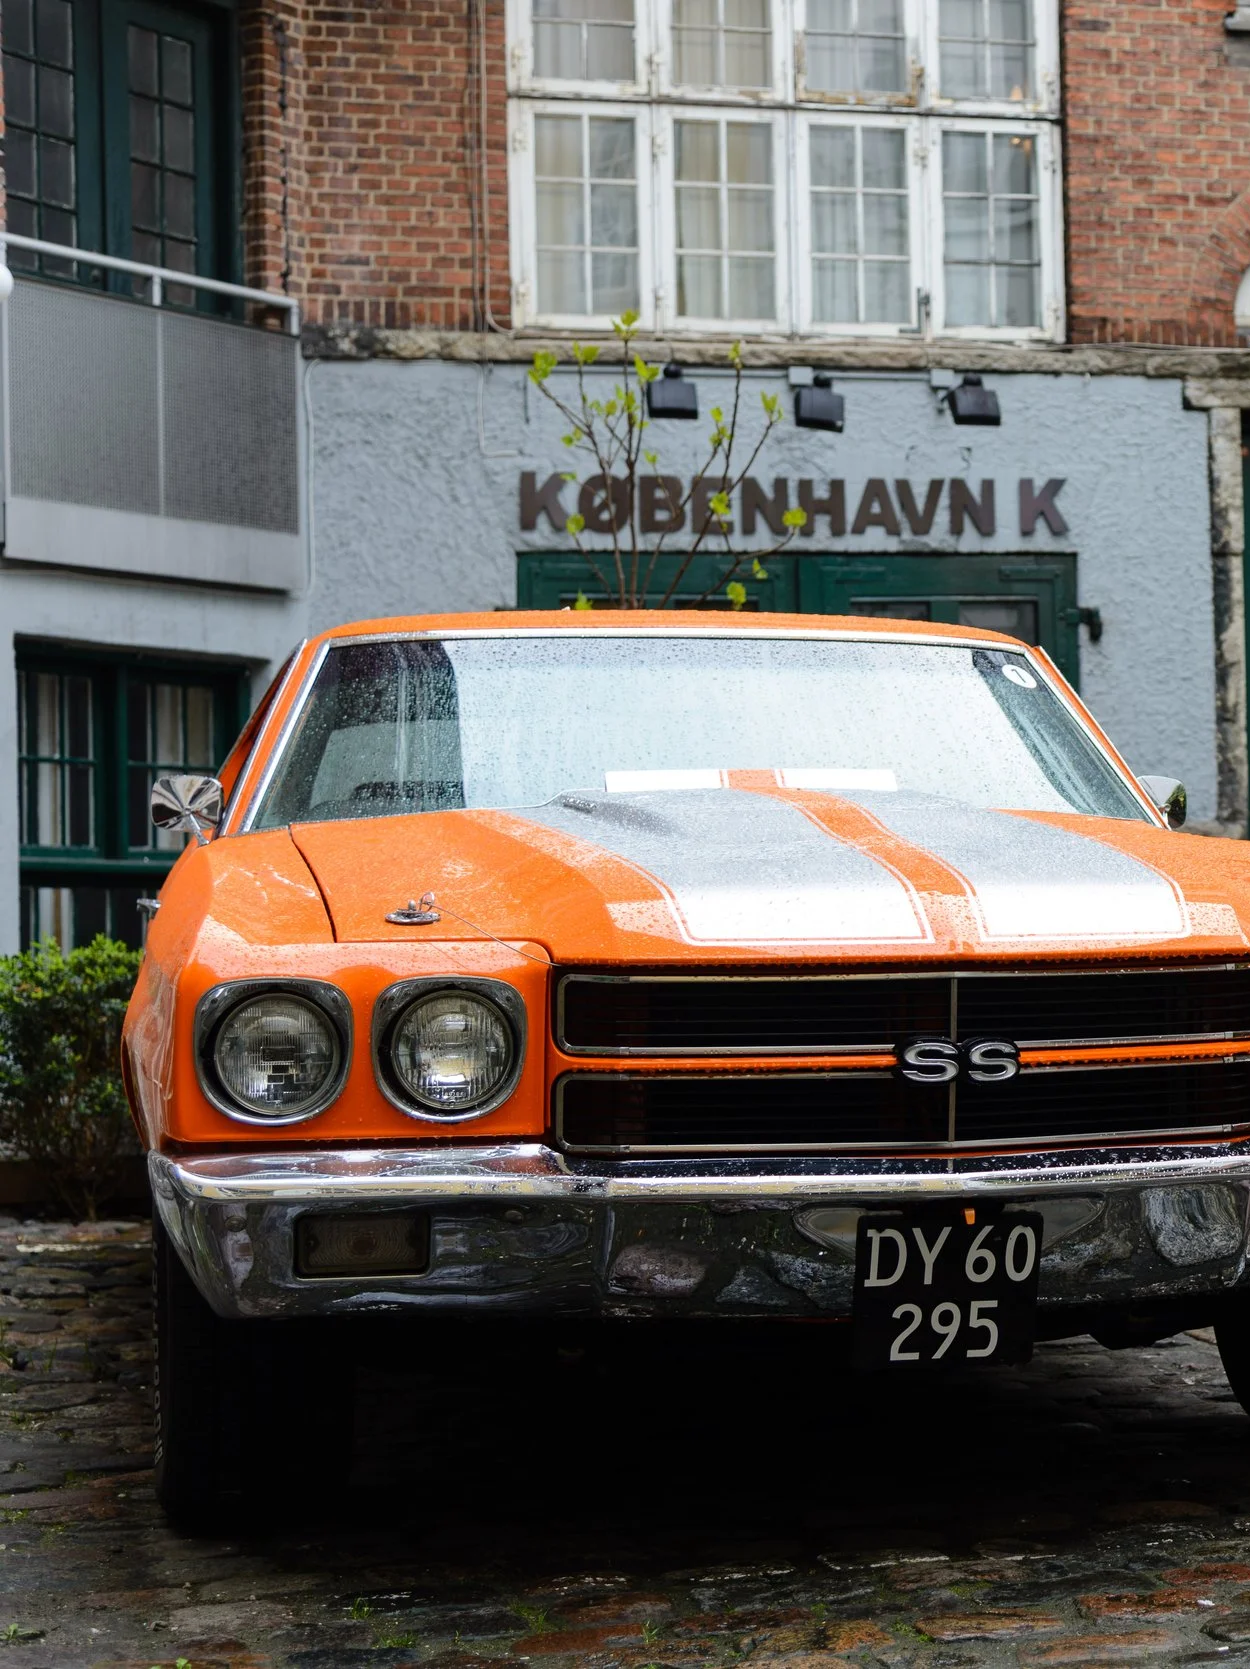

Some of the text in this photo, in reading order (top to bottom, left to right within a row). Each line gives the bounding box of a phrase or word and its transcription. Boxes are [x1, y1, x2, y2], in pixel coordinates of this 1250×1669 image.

[520, 471, 1070, 538] KØBENHAVN K
[901, 1042, 1018, 1082] SS
[864, 1224, 1036, 1287] DY 60
[889, 1300, 999, 1361] 295
